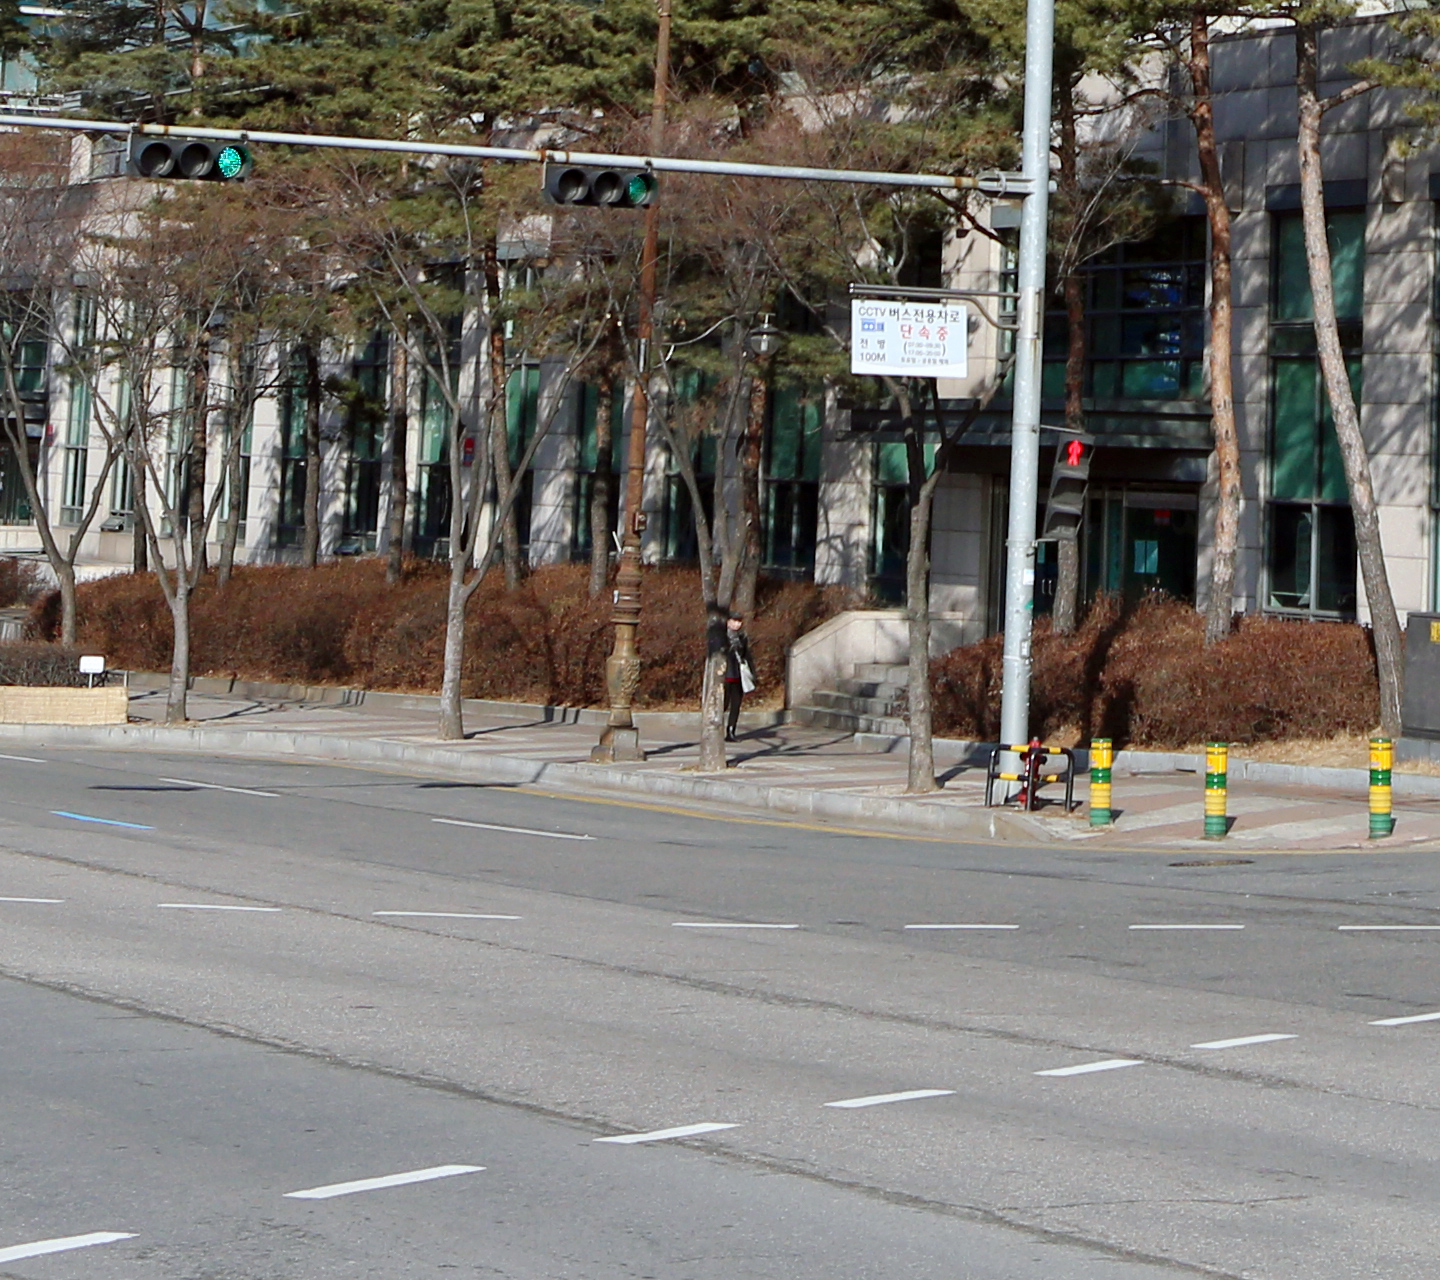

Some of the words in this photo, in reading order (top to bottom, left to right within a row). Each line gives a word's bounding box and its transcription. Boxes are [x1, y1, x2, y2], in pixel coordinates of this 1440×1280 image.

[858, 306, 887, 317] CCTV
[889, 307, 961, 324] 버스전용차로
[859, 352, 886, 363] 100M
